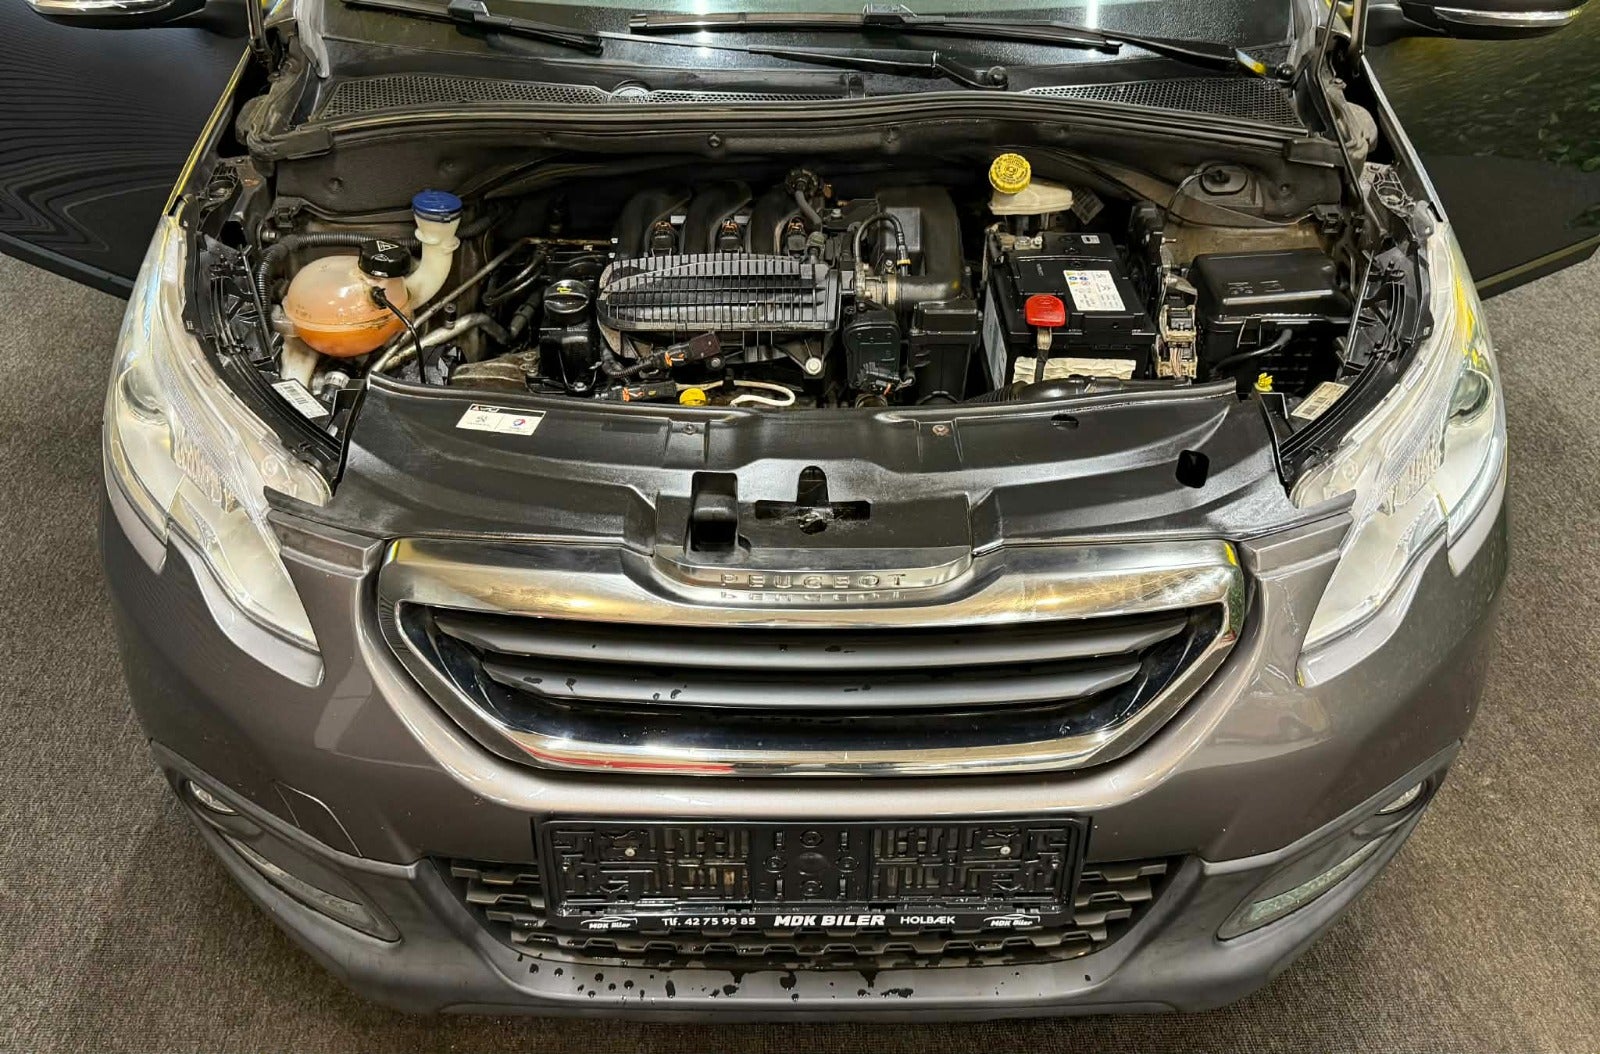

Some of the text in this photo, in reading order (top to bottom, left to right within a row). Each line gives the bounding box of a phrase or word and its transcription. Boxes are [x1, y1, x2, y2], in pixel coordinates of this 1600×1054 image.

[720, 573, 907, 589] PEUGEOT
[685, 917, 700, 926] 42
[703, 917, 718, 926] 75
[722, 917, 737, 926] 95
[740, 917, 756, 926] 85
[773, 915, 886, 927] MDK BILER
[900, 915, 956, 925] HOLBÆK
[990, 919, 1011, 927] MDK
[589, 922, 609, 930] MDK
